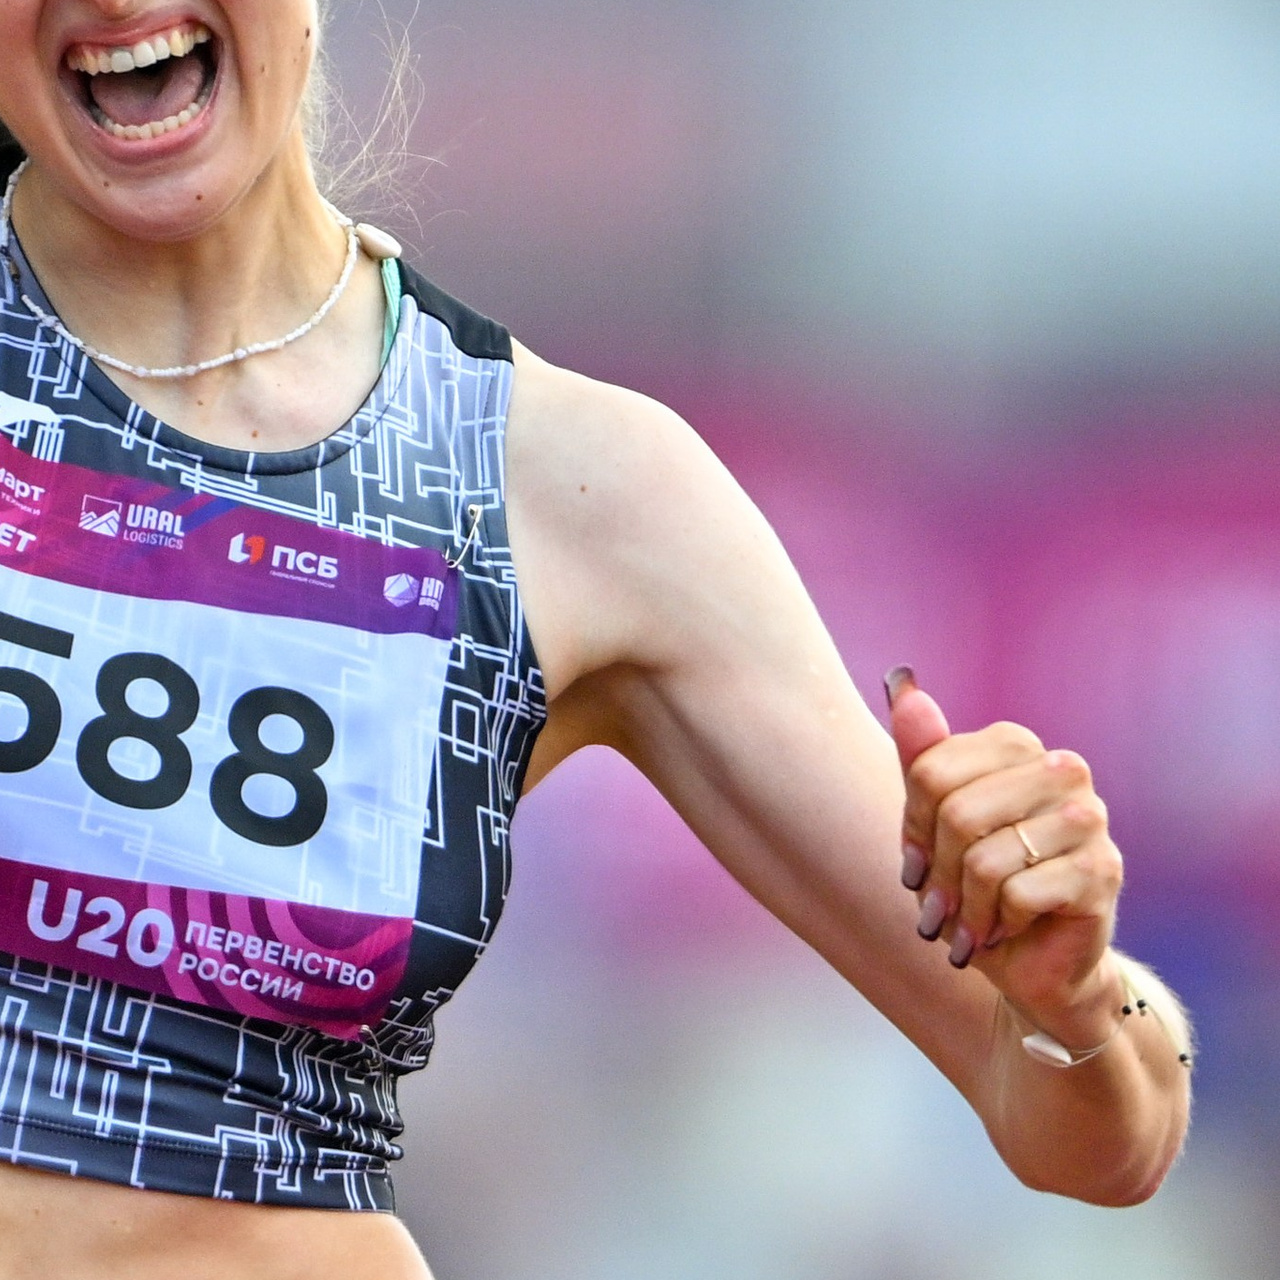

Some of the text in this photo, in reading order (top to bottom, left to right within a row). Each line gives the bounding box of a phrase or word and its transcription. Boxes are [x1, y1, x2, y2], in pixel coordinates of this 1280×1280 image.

[123, 529, 184, 550] LOGISTICS
[126, 504, 185, 537] URAL
[271, 545, 339, 579] ПСБ
[26, 878, 176, 968] U20
[184, 920, 376, 991] ПЕРВЕНСТВО
[177, 952, 305, 1001] РОССИИ
